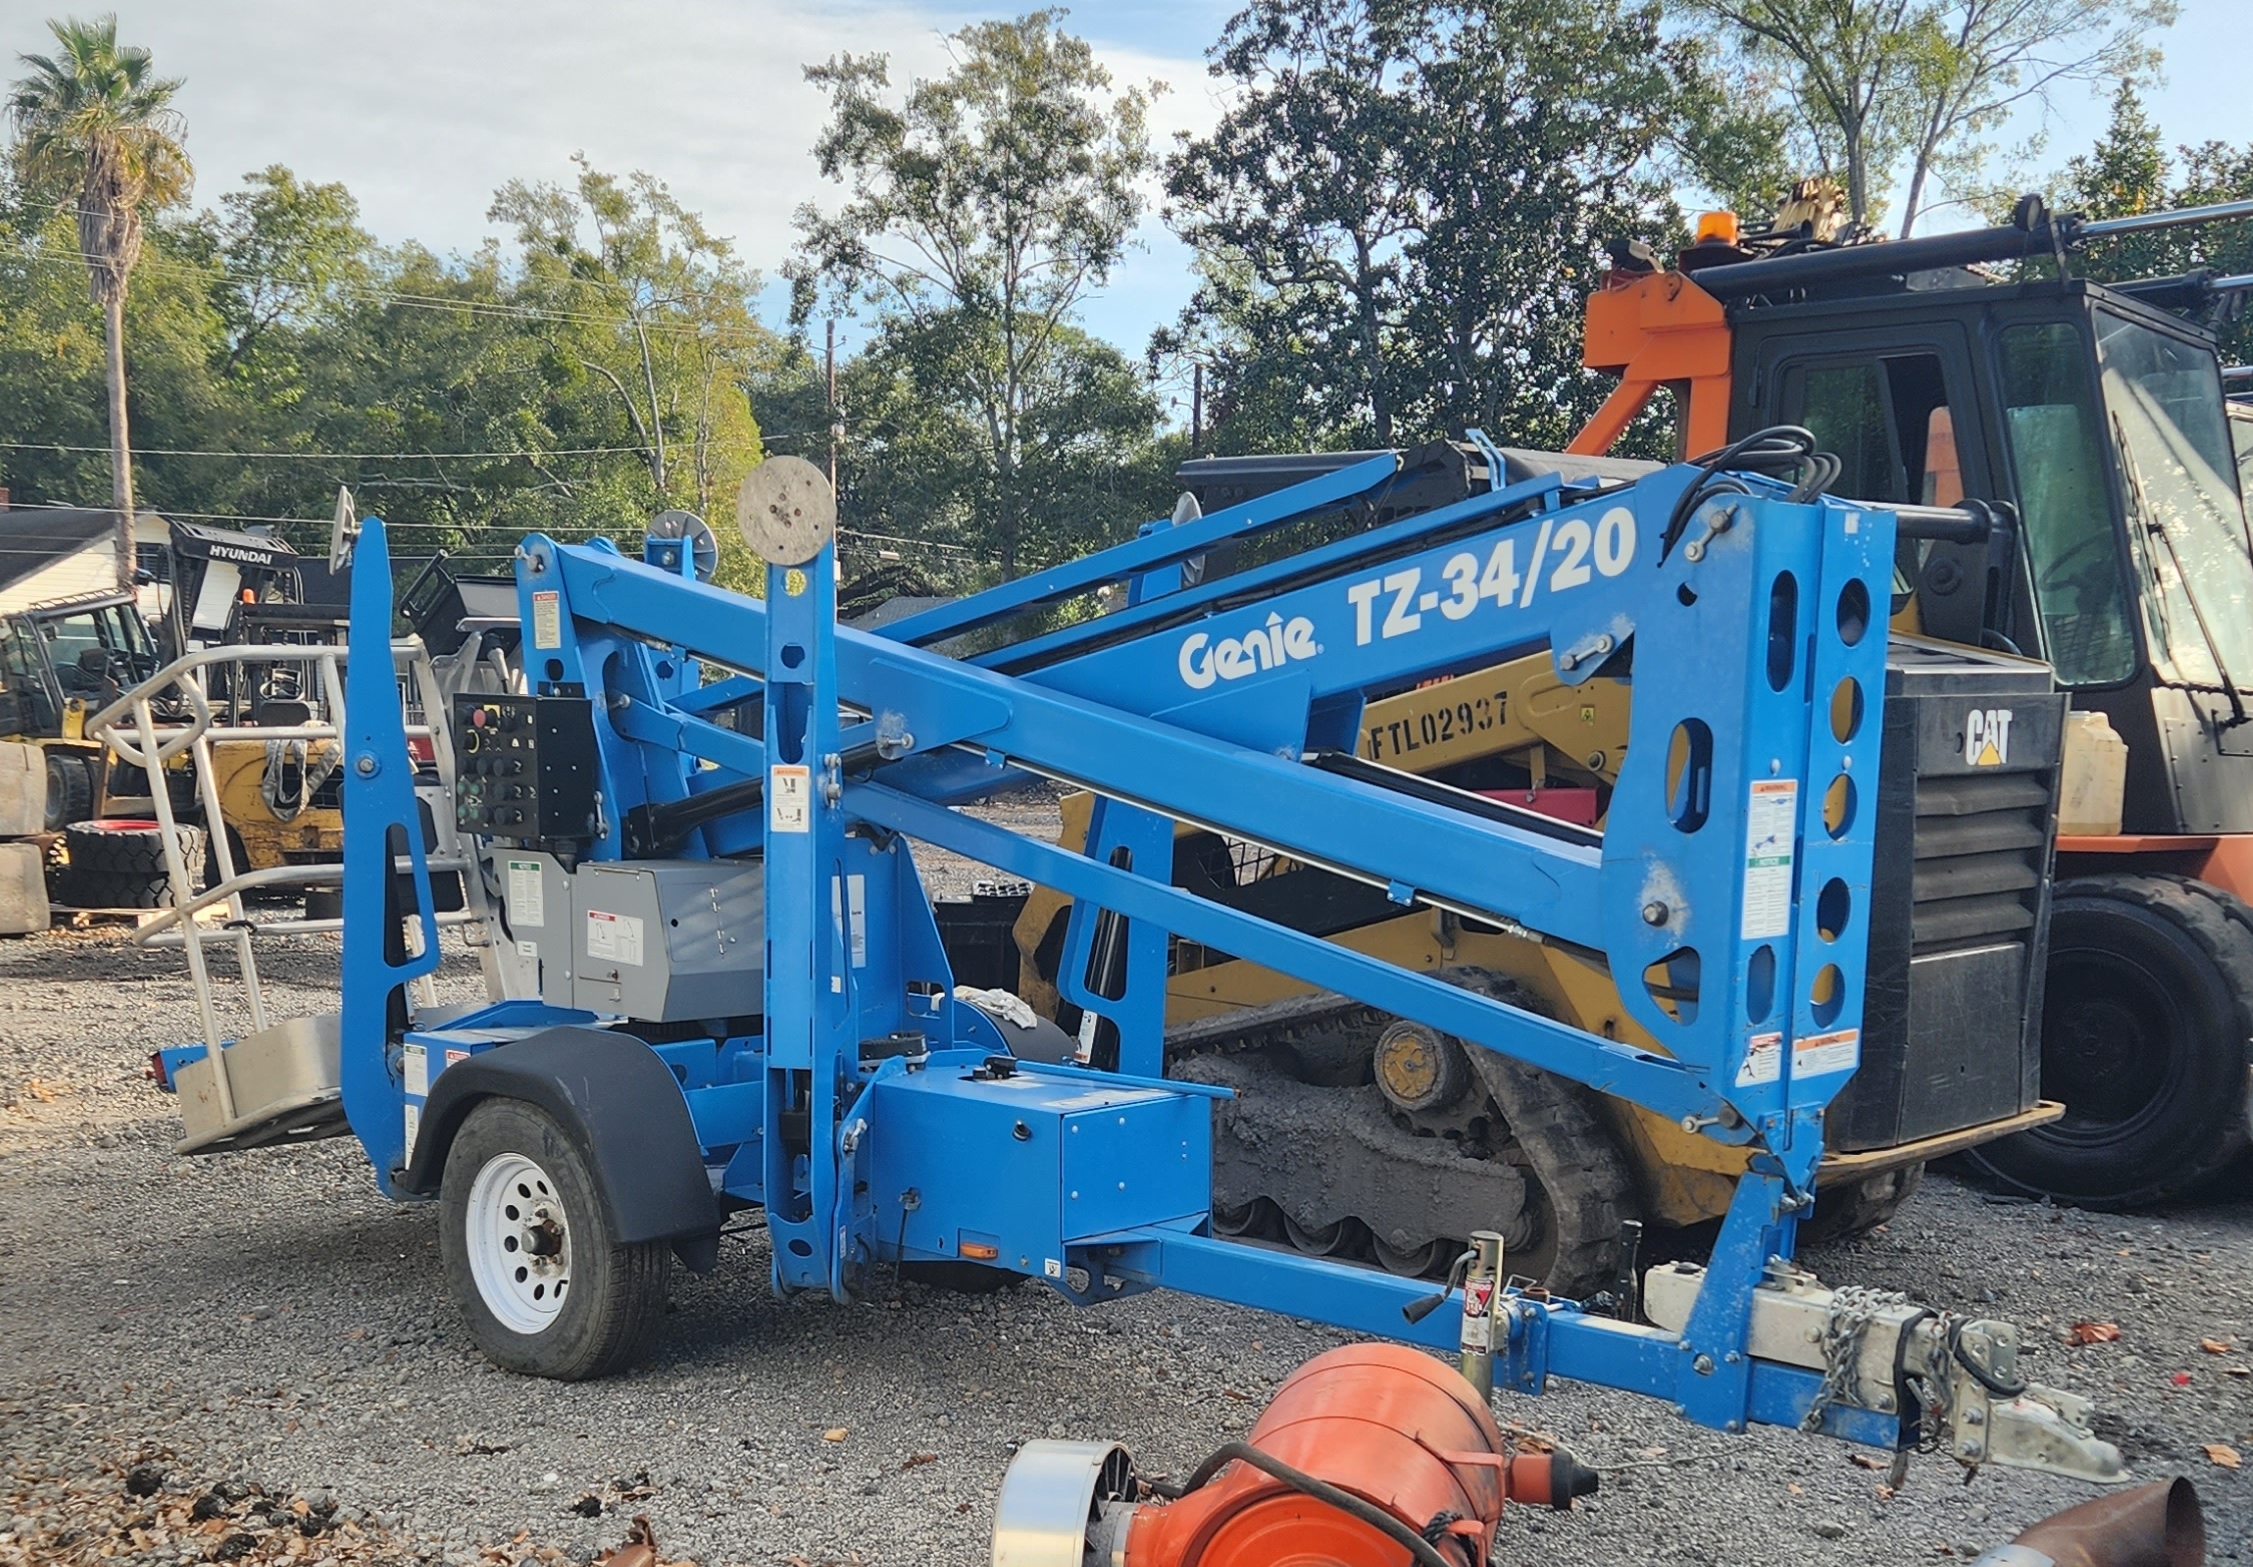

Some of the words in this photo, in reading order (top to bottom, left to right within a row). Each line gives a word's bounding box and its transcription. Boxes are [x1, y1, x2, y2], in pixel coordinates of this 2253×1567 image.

[209, 544, 273, 565] HYUNDAI
[1178, 611, 1318, 690] Genie
[1347, 506, 1637, 647] TZ-34/20
[1370, 691, 1508, 760] FTL02937
[1966, 708, 2013, 766] CAT
